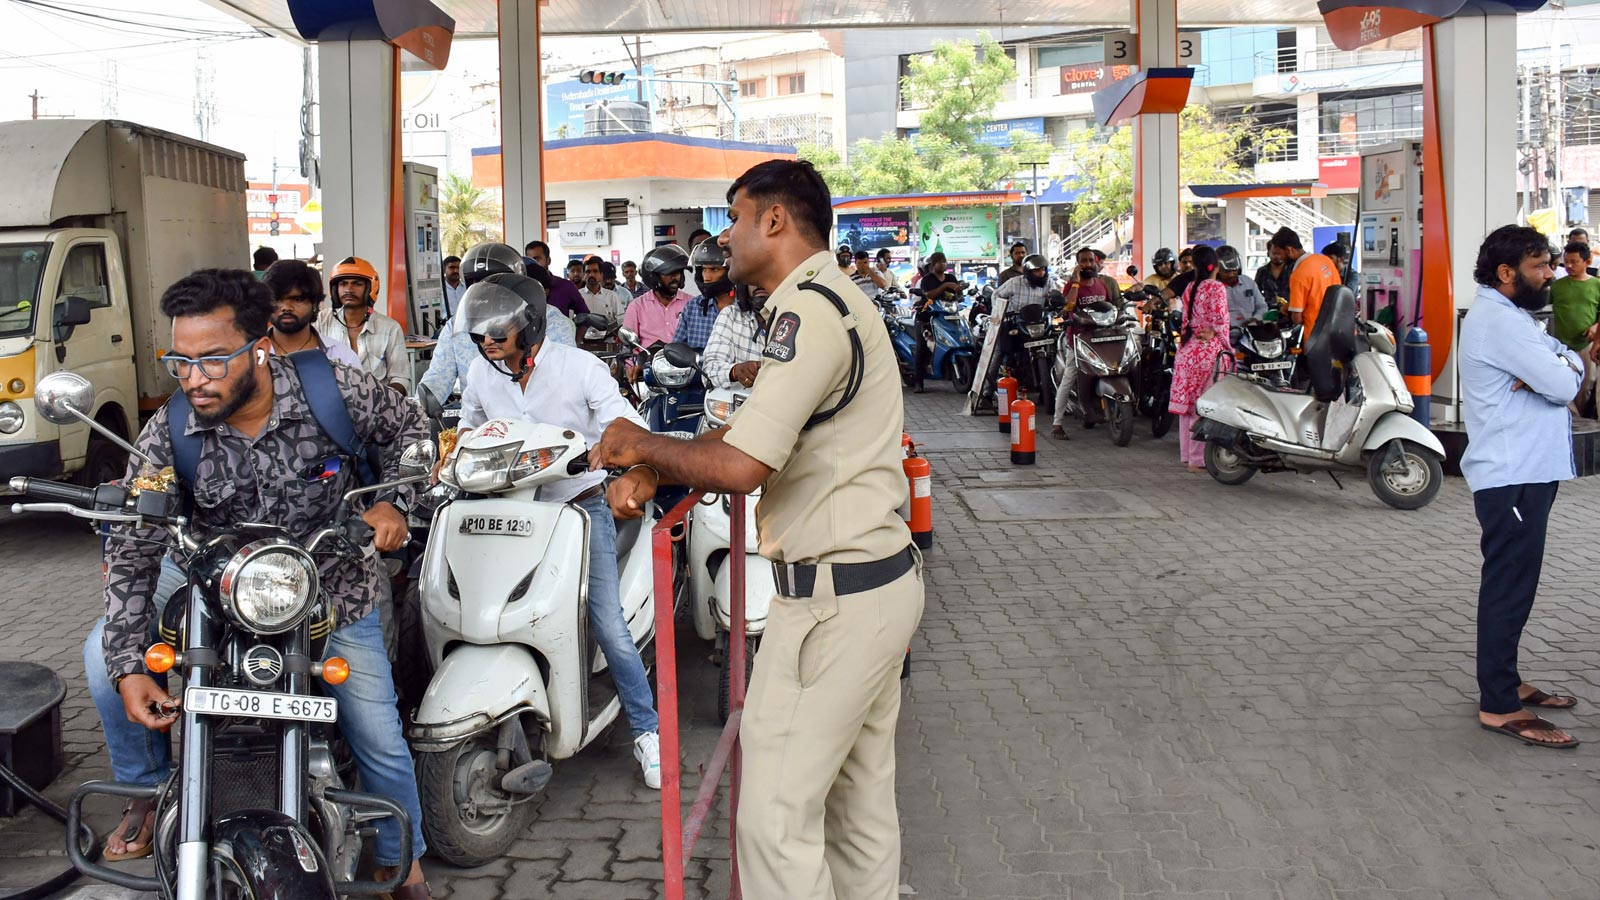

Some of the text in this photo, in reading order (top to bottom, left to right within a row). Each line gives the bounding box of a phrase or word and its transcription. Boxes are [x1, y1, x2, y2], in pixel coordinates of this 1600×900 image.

[1113, 40, 1127, 59] 3
[1179, 40, 1193, 58] 3
[414, 113, 439, 129] Oil
[986, 123, 1009, 133] CENTER
[461, 518, 485, 530] AP10
[488, 519, 503, 531] BE
[506, 519, 532, 533] 1290
[209, 692, 333, 718] TG 08 E 6675
